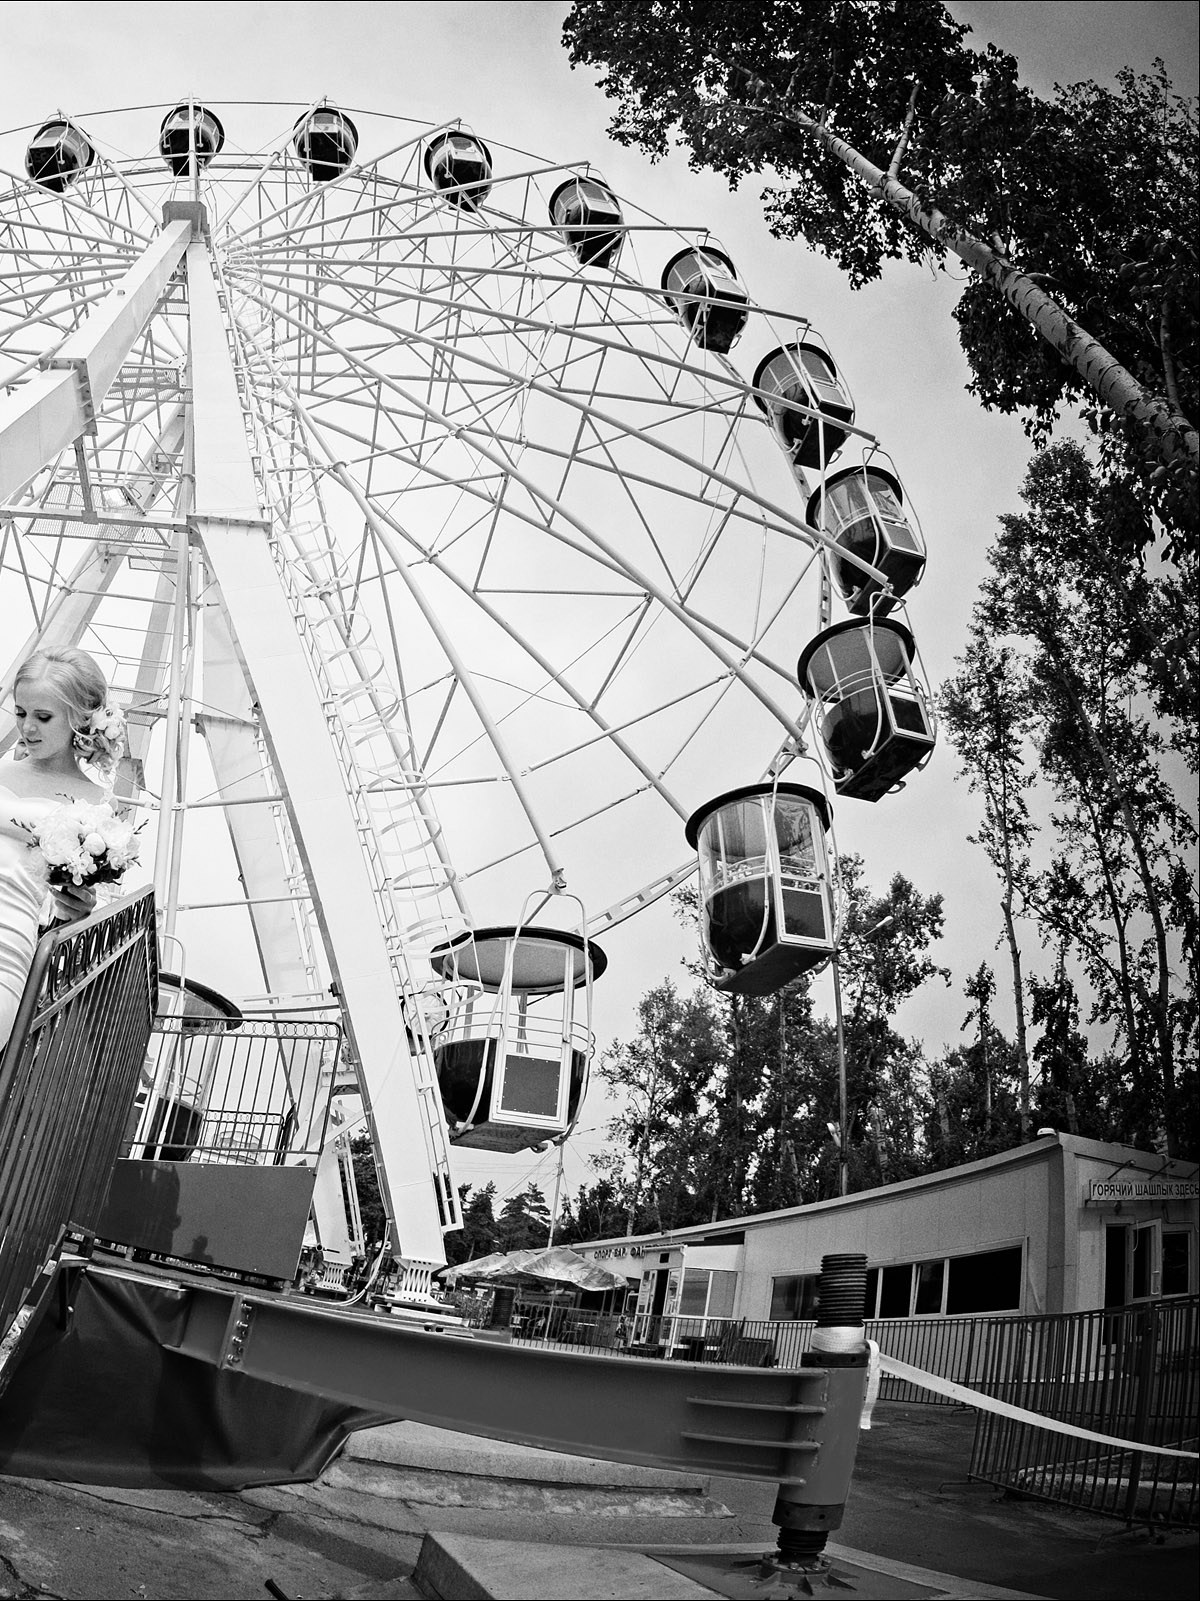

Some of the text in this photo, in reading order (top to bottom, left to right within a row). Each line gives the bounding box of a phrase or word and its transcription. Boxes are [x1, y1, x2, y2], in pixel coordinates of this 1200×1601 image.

[1092, 1182, 1199, 1197] ГОРЯЧИЙ ШАШЛЫК ЗДЕСЬ
